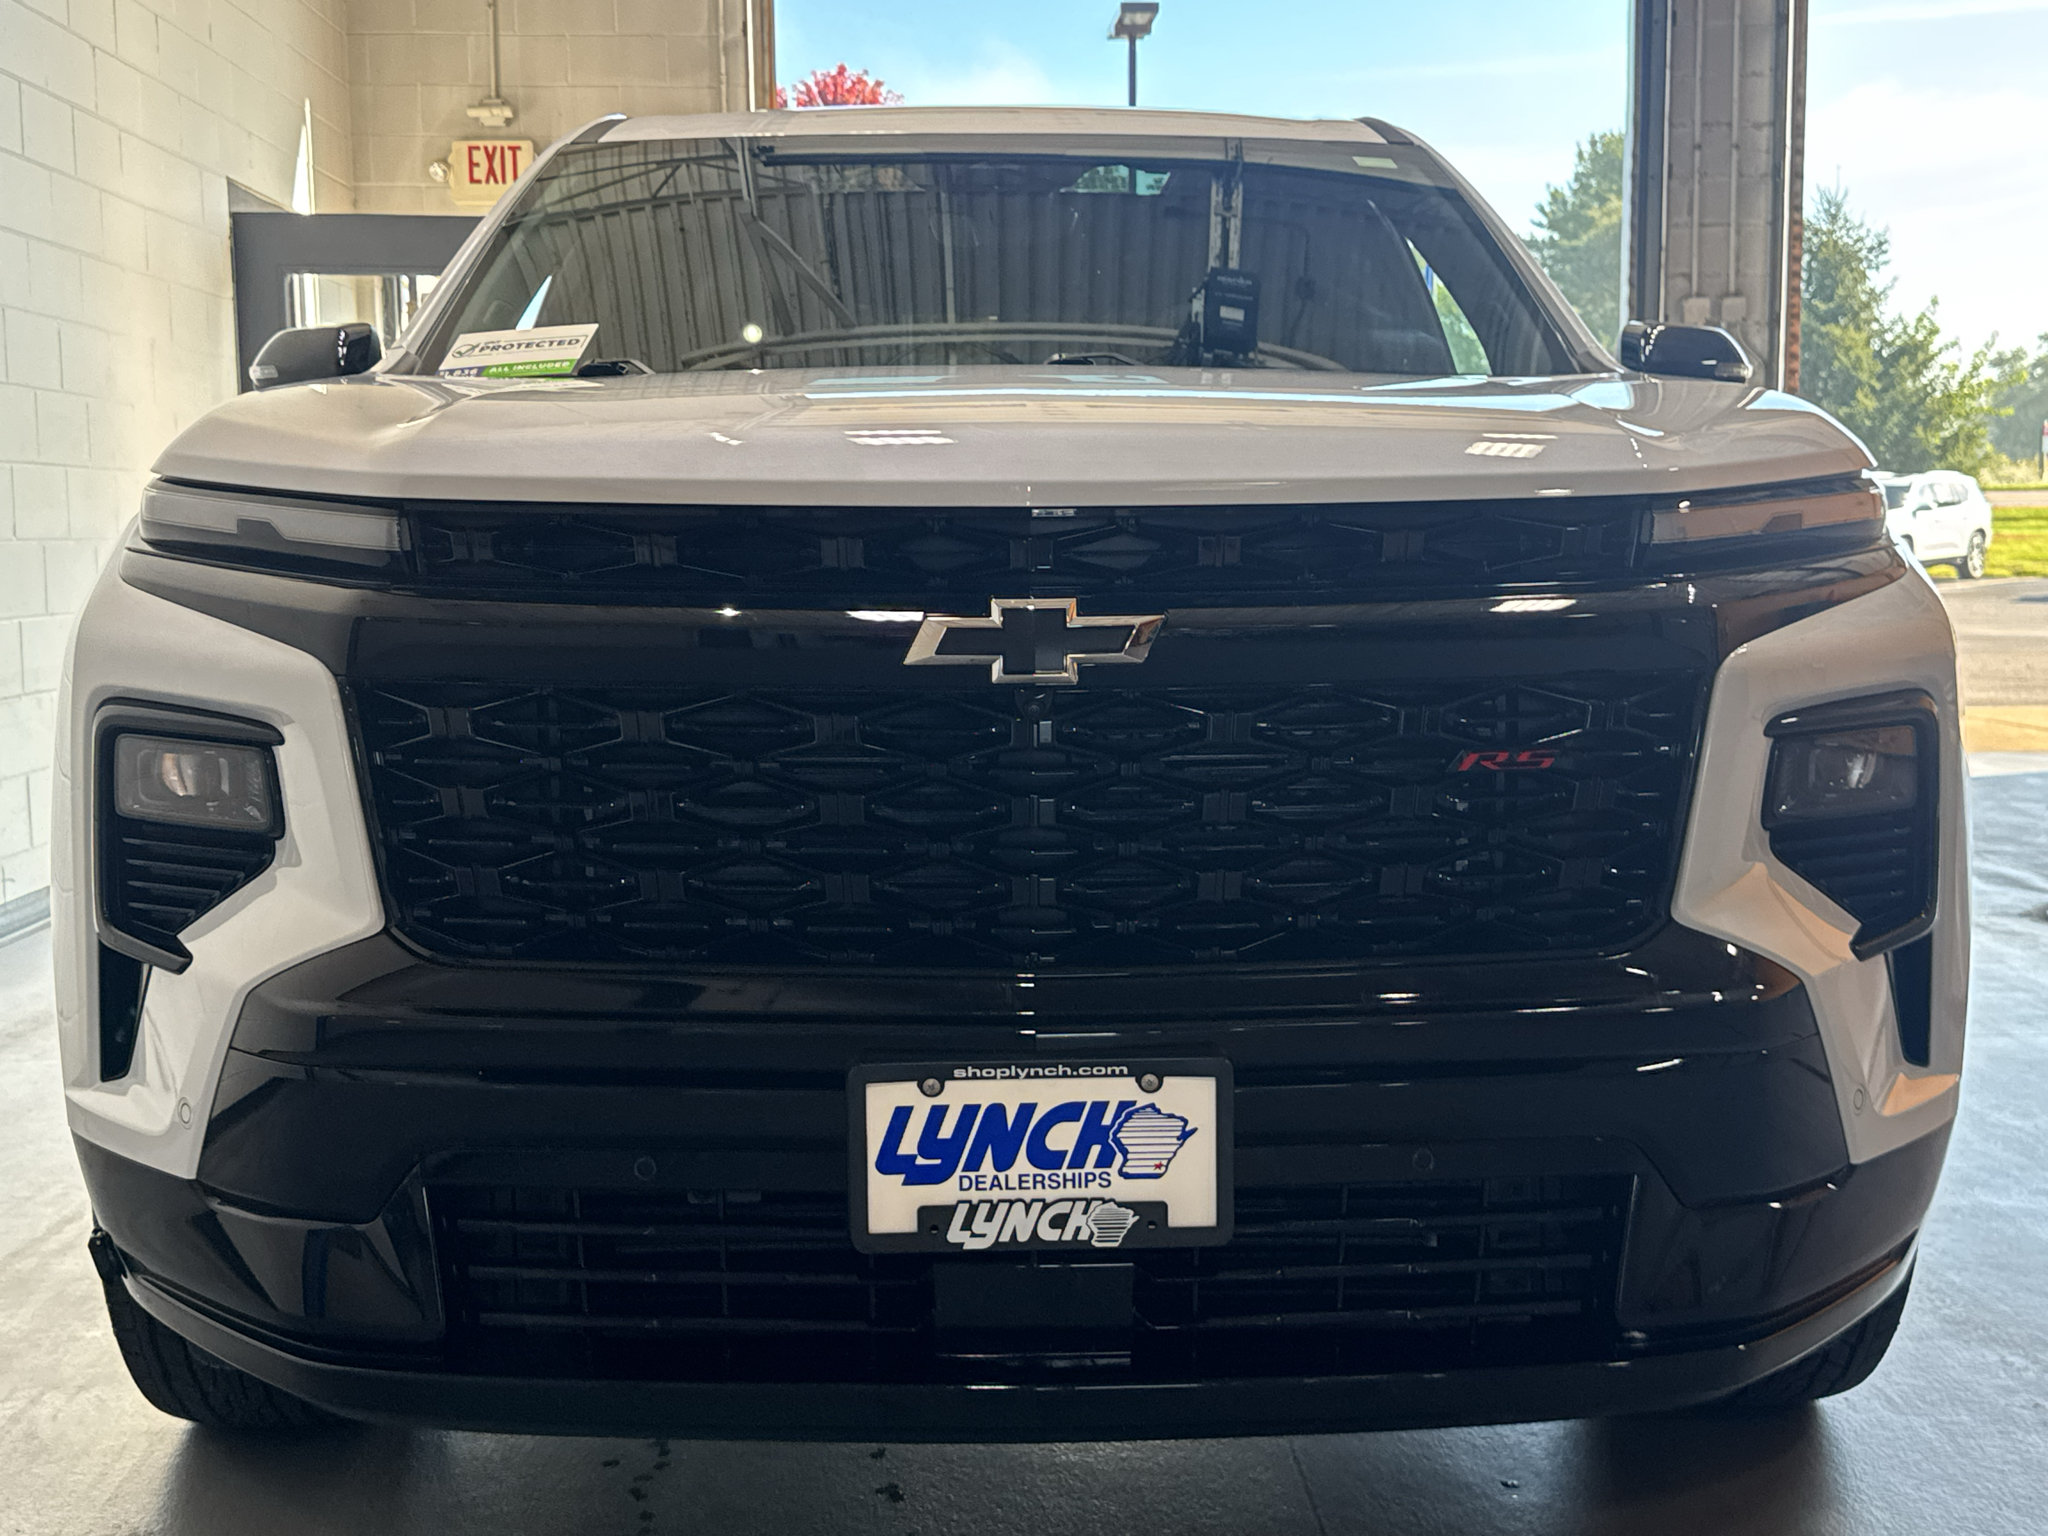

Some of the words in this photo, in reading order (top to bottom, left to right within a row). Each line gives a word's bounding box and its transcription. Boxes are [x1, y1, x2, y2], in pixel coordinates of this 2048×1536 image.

[467, 145, 521, 184] EXIT
[479, 338, 580, 353] PROTECTED
[489, 366, 509, 374] ALL
[512, 361, 571, 371] INCLUDED
[1457, 750, 1558, 771] RS
[953, 1064, 1129, 1079] shoplynch.com
[875, 1100, 1137, 1186] LYNCH
[958, 1171, 1112, 1192] DEALERSHIPS
[946, 1199, 1109, 1250] LYNCH
